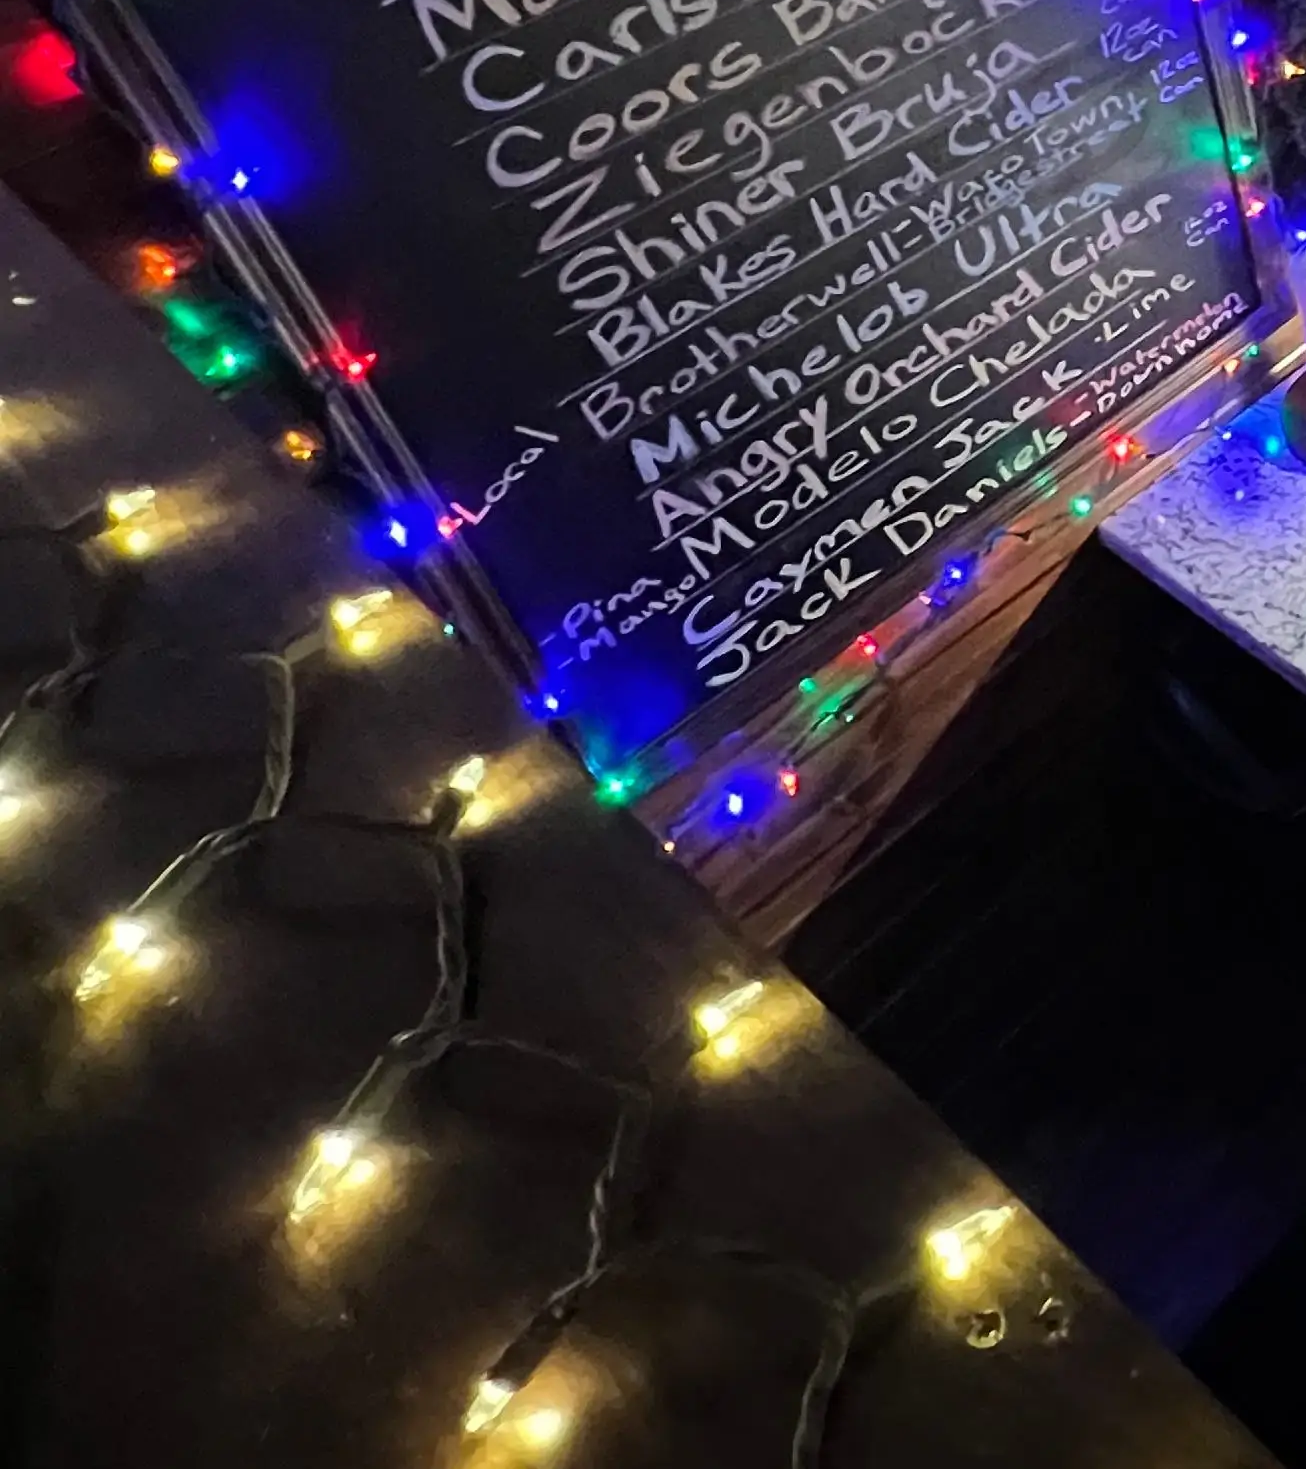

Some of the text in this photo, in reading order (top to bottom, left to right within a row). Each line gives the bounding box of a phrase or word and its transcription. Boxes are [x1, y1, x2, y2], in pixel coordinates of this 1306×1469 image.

[486, 41, 763, 188] Coors
[557, 41, 1041, 312] Shiner Bruja
[587, 75, 1085, 369] Blakes Hard Cider
[629, 182, 1123, 484] Michelob Ultra
[652, 192, 1172, 538] Angry Orchard Cider
[680, 265, 1157, 582] Modelo Chelada
[935, 359, 1084, 470] Jack
[450, 425, 560, 526] Local
[697, 423, 1070, 688] Jack Daniels
